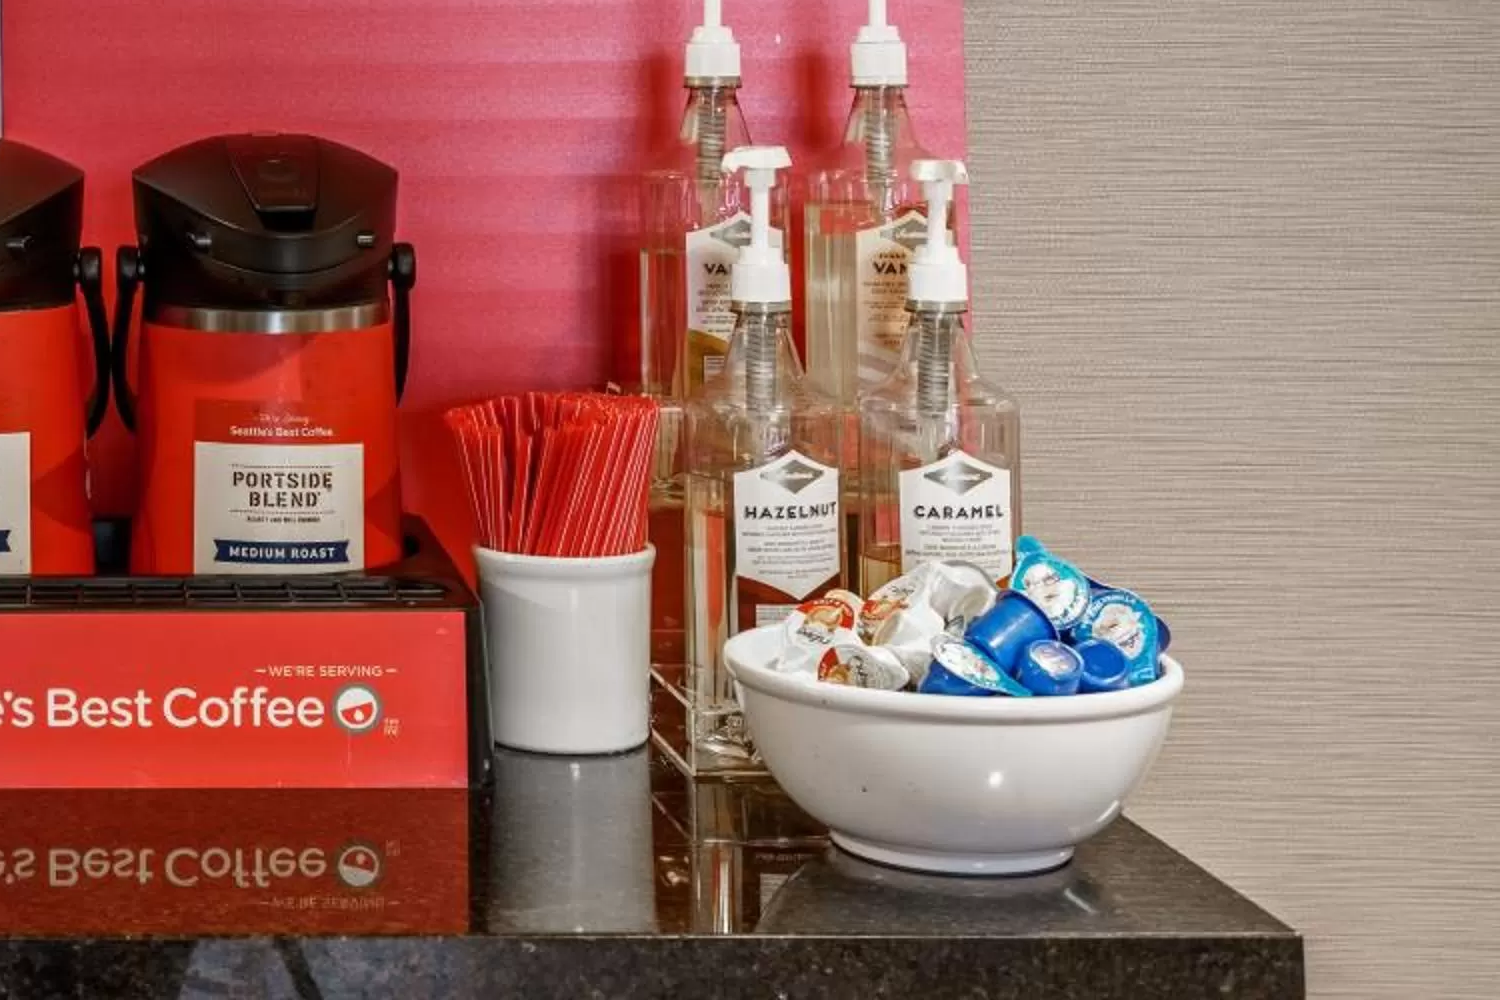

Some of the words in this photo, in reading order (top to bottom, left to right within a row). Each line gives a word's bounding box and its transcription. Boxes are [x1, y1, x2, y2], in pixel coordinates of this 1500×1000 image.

[233, 471, 333, 488] PORTSIDE
[744, 501, 837, 520] HAZELNUT
[913, 505, 1004, 519] CARAMEL
[229, 546, 286, 558] MEDIUM
[290, 546, 335, 558] ROAST
[268, 665, 315, 677] WE'RE
[319, 665, 383, 677] SERVING
[45, 687, 153, 728] Best
[162, 686, 325, 728] Coffee
